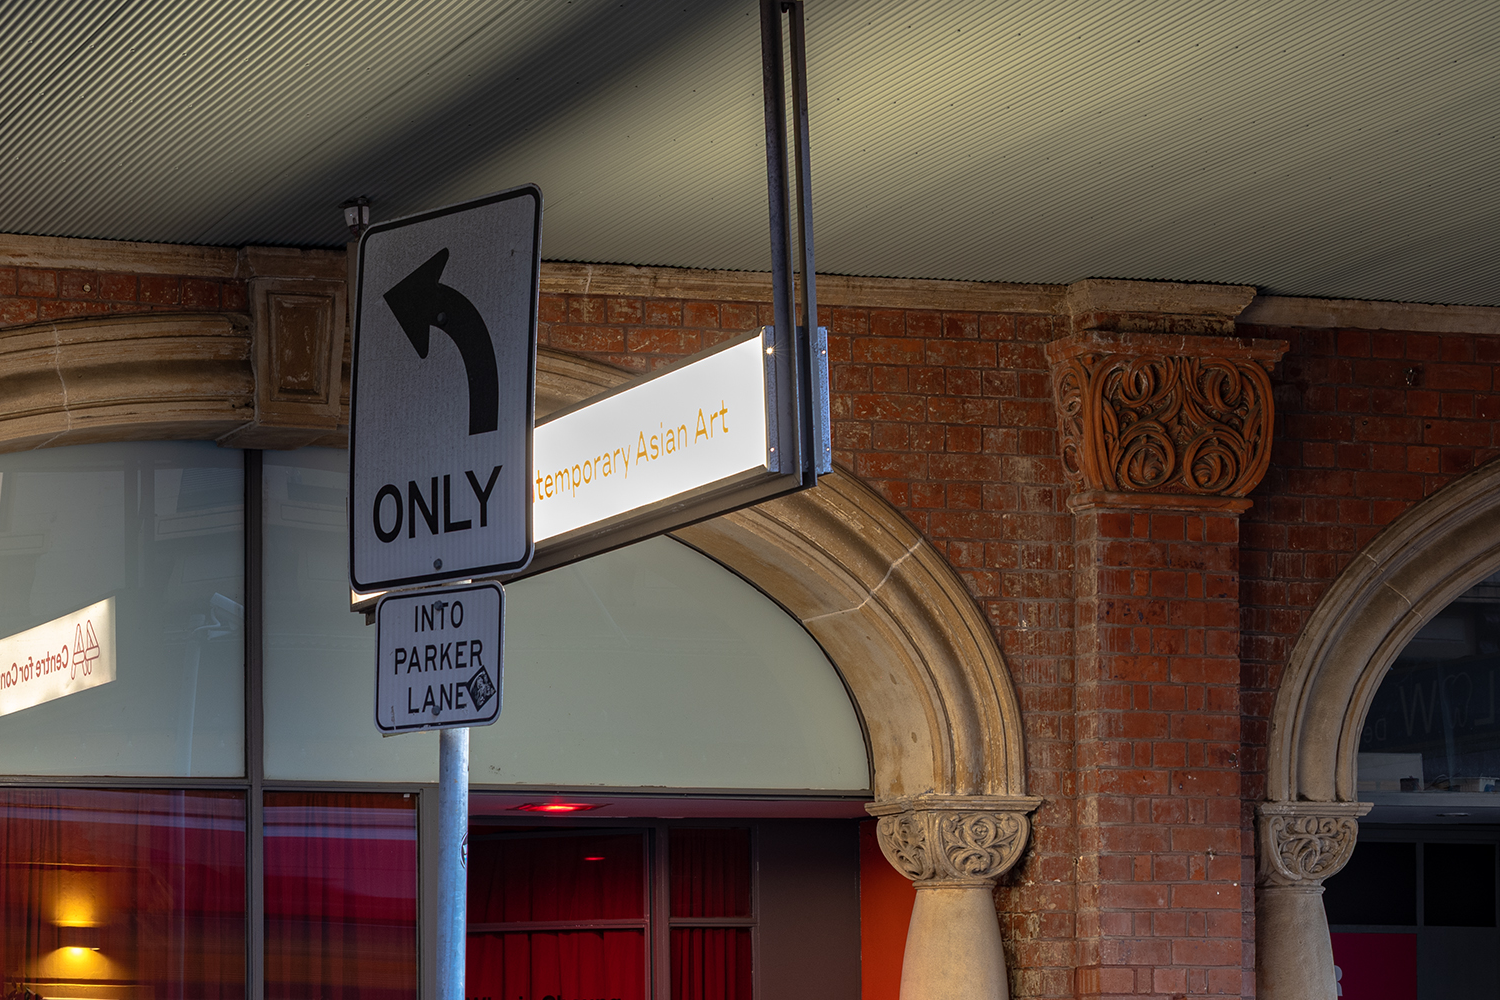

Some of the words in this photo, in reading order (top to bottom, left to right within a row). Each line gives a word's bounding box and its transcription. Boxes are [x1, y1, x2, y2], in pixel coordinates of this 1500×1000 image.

[533, 444, 631, 503] temporary
[635, 422, 688, 466] Asian
[694, 399, 729, 444] Art
[373, 465, 503, 543] ONLY
[414, 601, 464, 633] INTO
[394, 639, 483, 675] PARKER
[408, 681, 468, 714] LANE
